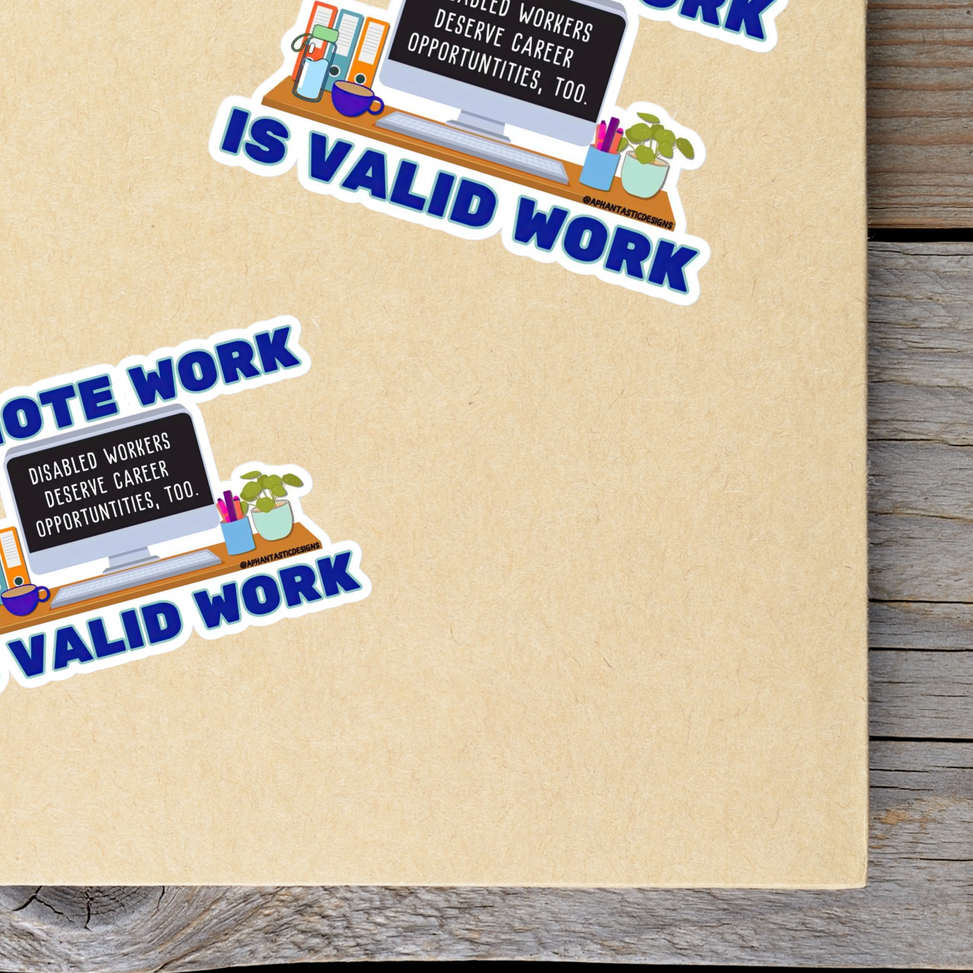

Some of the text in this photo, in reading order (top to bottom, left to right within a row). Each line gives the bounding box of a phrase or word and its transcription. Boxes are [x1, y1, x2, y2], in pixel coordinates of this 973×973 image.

[434, 8, 574, 69] DESERVE CAREER
[519, 2, 593, 43] WORKERS
[407, 32, 590, 107] OPPORTUNTITIES, TOO.
[219, 106, 700, 295] IS VALID WORK
[583, 196, 673, 229] @APHANTASTICDESIGNS
[126, 325, 302, 408] WORK
[28, 432, 171, 485] DISABLED WORKERS
[44, 460, 169, 508] DESERVE CAREER
[35, 480, 200, 538] OPPORTUNTITIES, TOO.
[240, 542, 319, 569] @APHANTASTICDESIGNS
[6, 600, 183, 679] VALID
[191, 550, 363, 630] WORK
